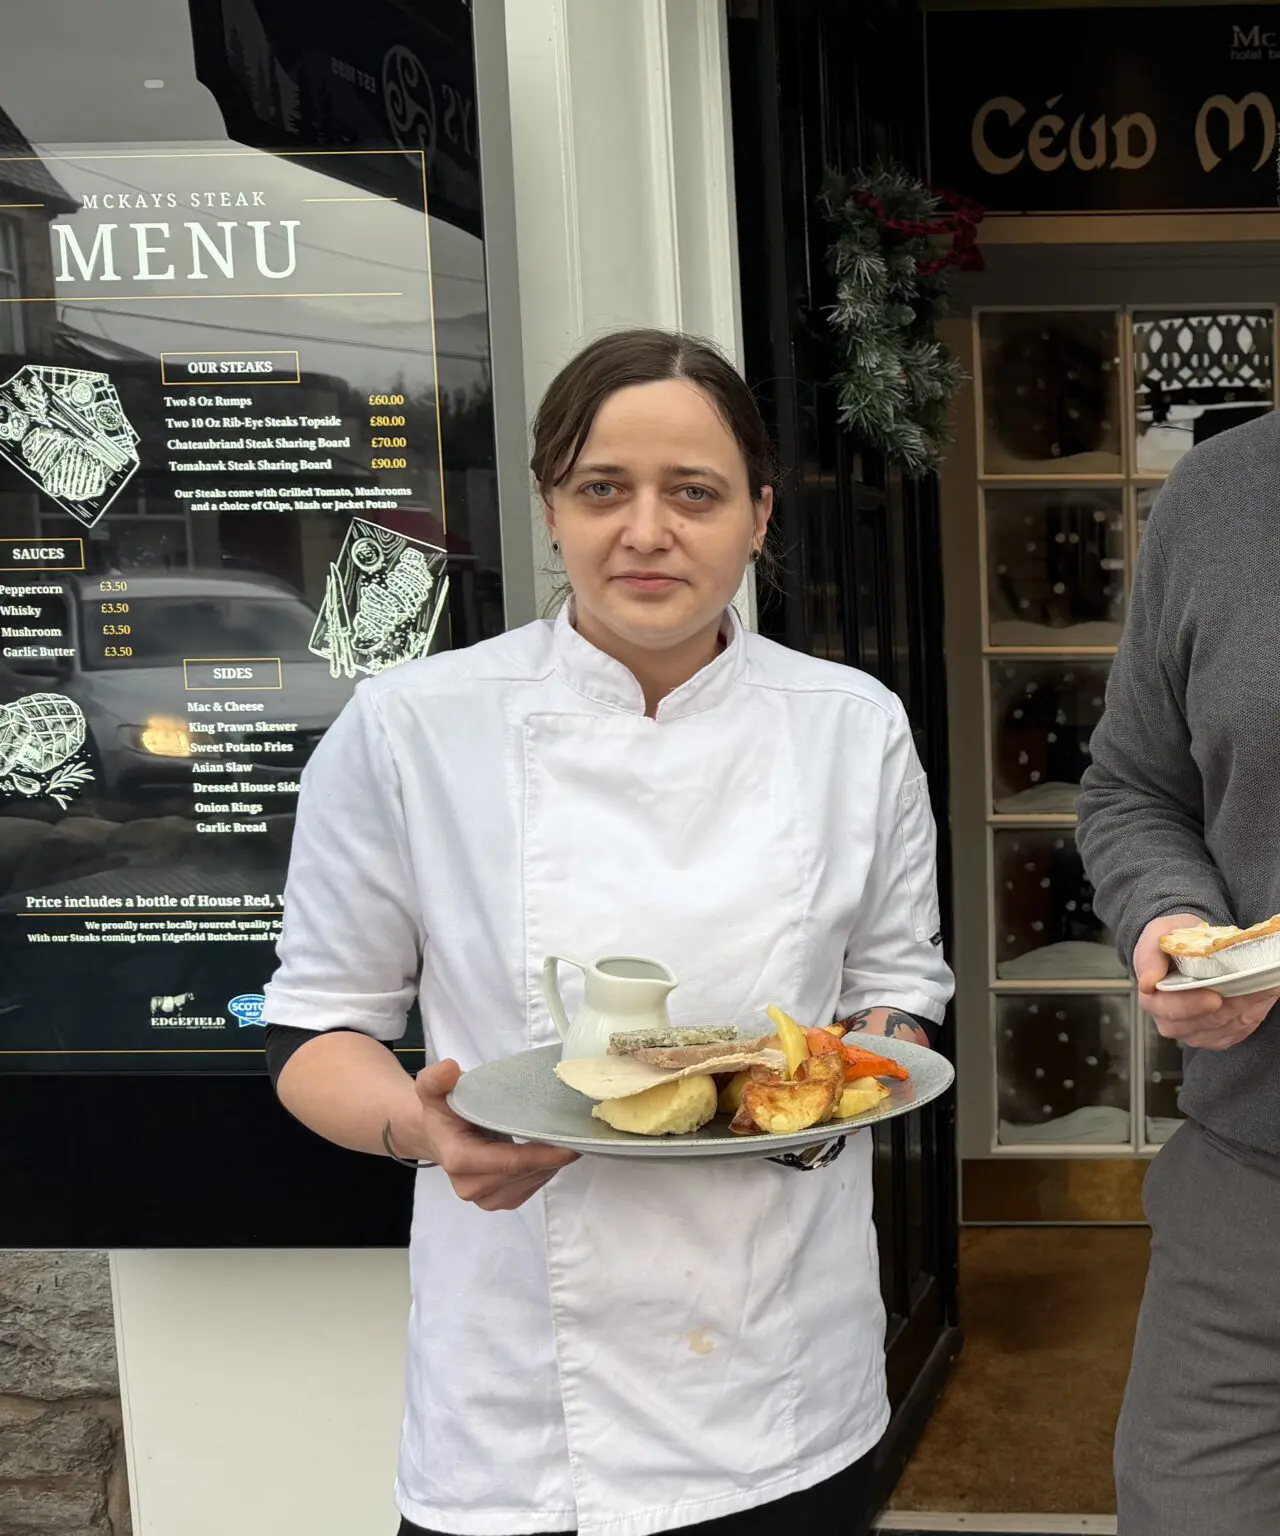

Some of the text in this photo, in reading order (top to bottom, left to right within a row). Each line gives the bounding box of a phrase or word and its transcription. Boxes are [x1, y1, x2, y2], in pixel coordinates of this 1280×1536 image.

[83, 192, 266, 209] MCKAYS STEAK
[52, 221, 300, 282] MENU
[188, 360, 272, 374] OUR STEAKS
[164, 396, 252, 408] Two 8 Oz Rumps
[369, 395, 404, 406] £60.00
[165, 415, 342, 430] Two 10 Oz Rib-Eye Steaks Topside
[370, 416, 405, 427] £80.00
[167, 437, 350, 450] Chateaubriand Steak Sharing Board
[371, 437, 406, 448] £70.00
[168, 459, 332, 473] Tomahawk Steak Sharing Board
[371, 458, 406, 469] £90.00
[175, 487, 412, 498] Our Steaks come with Grilled Tomato, Mushrooms
[191, 502, 209, 511] and
[219, 502, 250, 511] choice
[251, 501, 262, 511] of
[263, 501, 293, 512] Chips,
[295, 501, 320, 509] Mash
[334, 500, 364, 511] Jacket
[366, 500, 398, 509] Potato
[12, 548, 65, 560] SAUCES
[0, 585, 63, 597] Peppercorn
[100, 581, 128, 591] £3.50
[0, 606, 42, 618] Whisky
[101, 603, 129, 613] £3.50
[1, 627, 62, 637] Mushroom
[103, 625, 130, 635] £3.50
[3, 647, 76, 657] Garlic Butter
[104, 646, 132, 657] £3.50
[213, 668, 253, 679] SIDES
[187, 702, 264, 712] Mac & Cheese
[188, 721, 298, 734] King Prawn Skewer
[190, 742, 294, 752] Sweet Potato Fries
[192, 762, 253, 773] Asian Slaw
[193, 782, 238, 792] Dressed
[240, 782, 275, 792] House
[195, 803, 263, 814] Onion Rings
[196, 822, 267, 833] Garlic Bread
[25, 896, 62, 908] Price
[64, 895, 122, 908] includes
[125, 898, 134, 907] a
[136, 895, 178, 907] bottle
[180, 895, 195, 907] of
[197, 895, 241, 907] House
[244, 894, 274, 908] Red,
[85, 921, 100, 930] We
[102, 921, 138, 931] proudly
[166, 920, 198, 931] locally
[200, 920, 236, 929] sourced
[238, 920, 271, 930] quality
[27, 933, 50, 942] With
[70, 933, 100, 942] Steaks
[102, 933, 136, 944] coming
[137, 933, 160, 942] from
[162, 932, 206, 943] Edgefield
[207, 932, 248, 941] Butchers
[250, 932, 268, 941] and
[232, 1002, 264, 1012] SCOTC
[151, 1017, 226, 1026] EDGEFIELD
